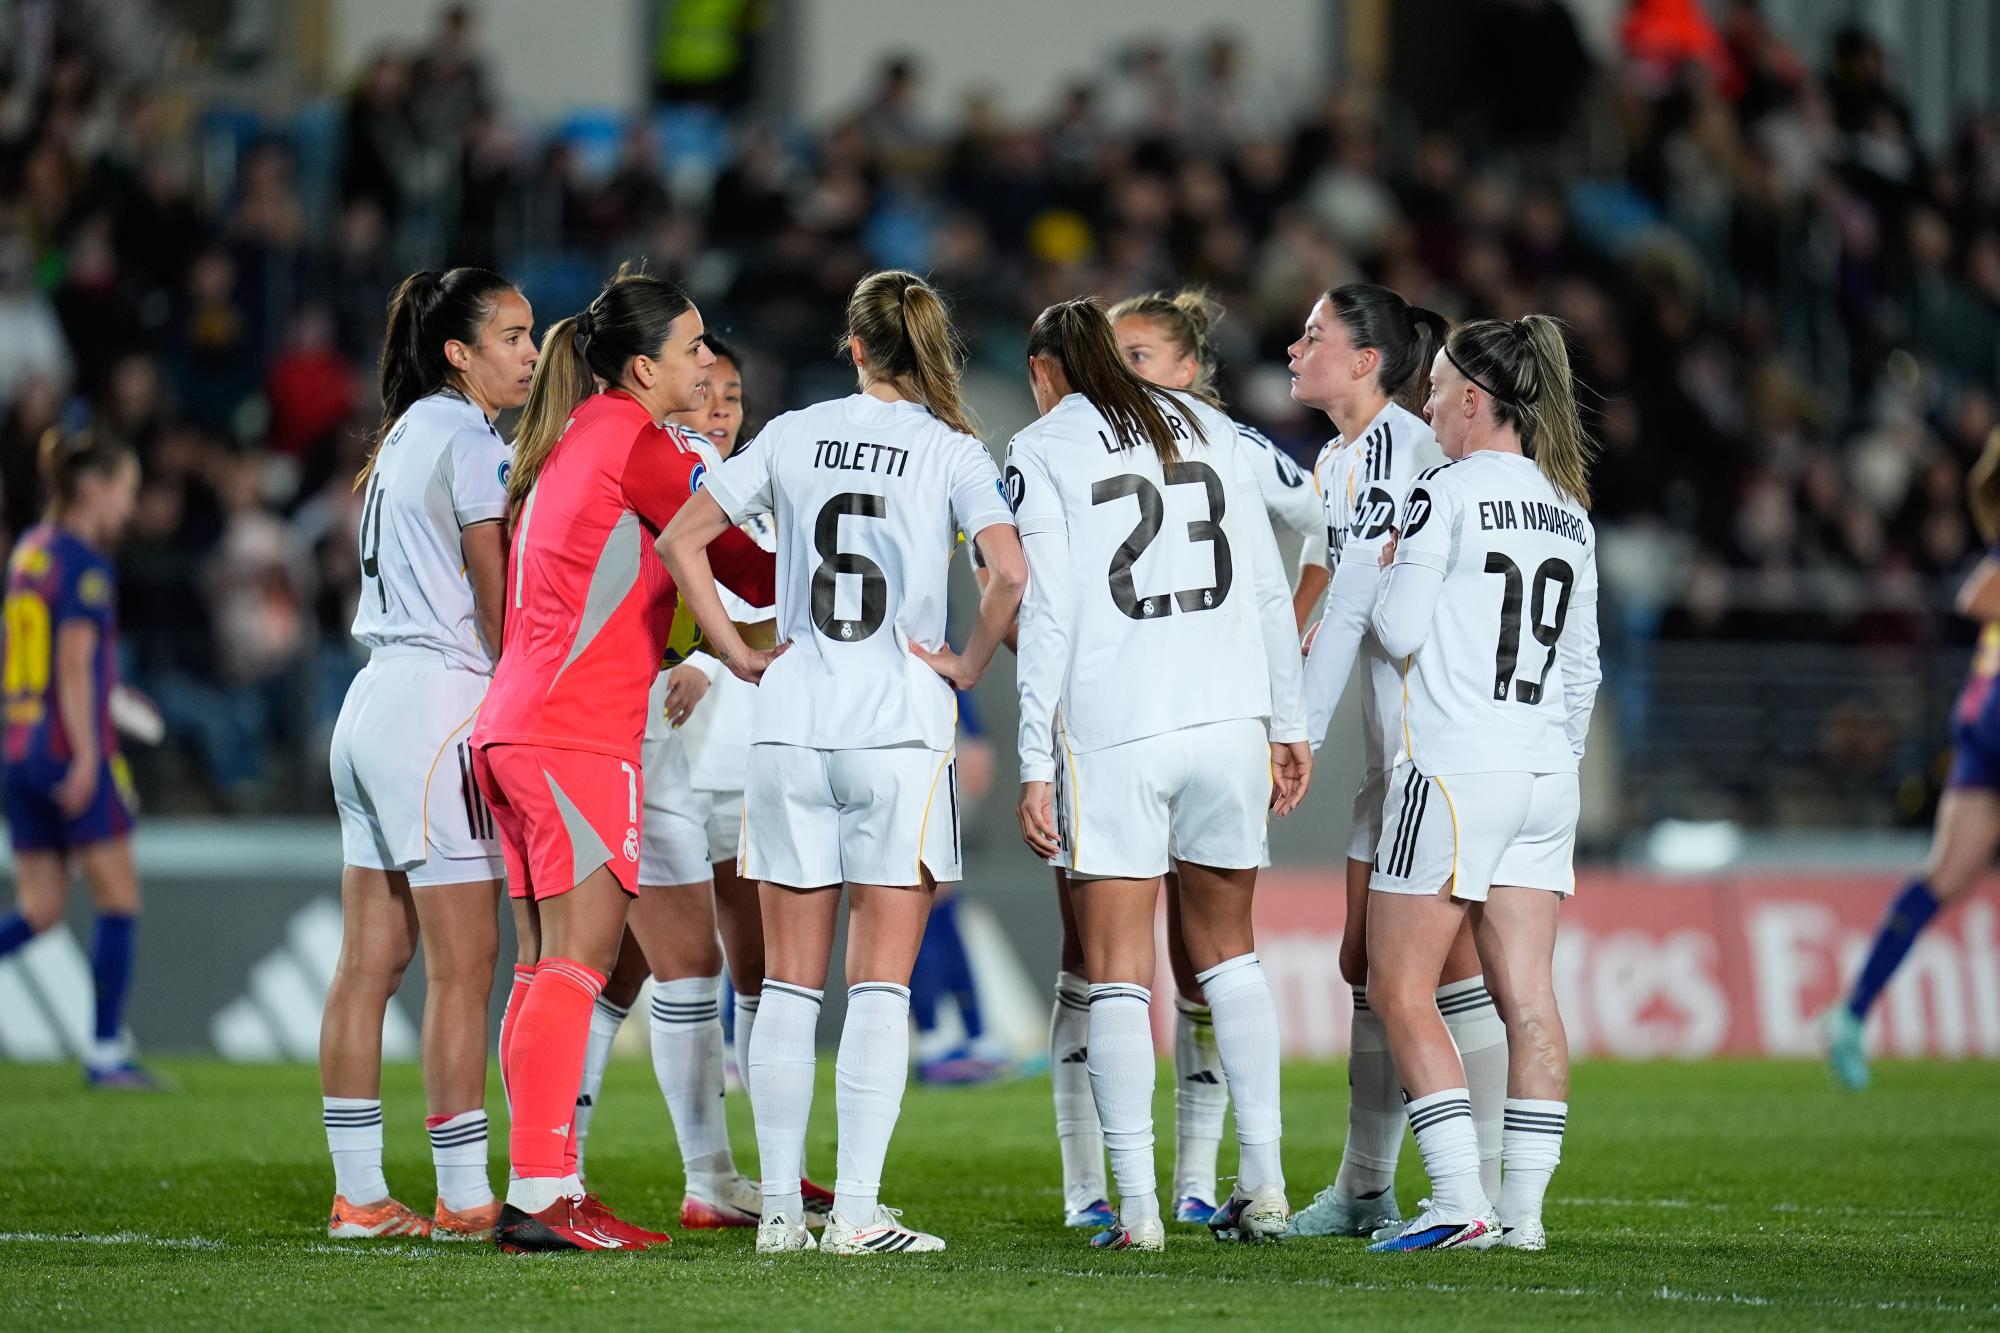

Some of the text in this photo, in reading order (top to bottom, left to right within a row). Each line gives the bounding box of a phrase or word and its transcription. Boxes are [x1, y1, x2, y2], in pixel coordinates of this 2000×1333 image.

[813, 440, 909, 477] TOLETTI
[1091, 461, 1233, 620] 23
[1351, 487, 1393, 540] hp
[1479, 501, 1587, 546] EVA NAVARRO
[811, 492, 887, 642] 6
[1484, 551, 1574, 705] 19
[621, 761, 637, 824] 1
